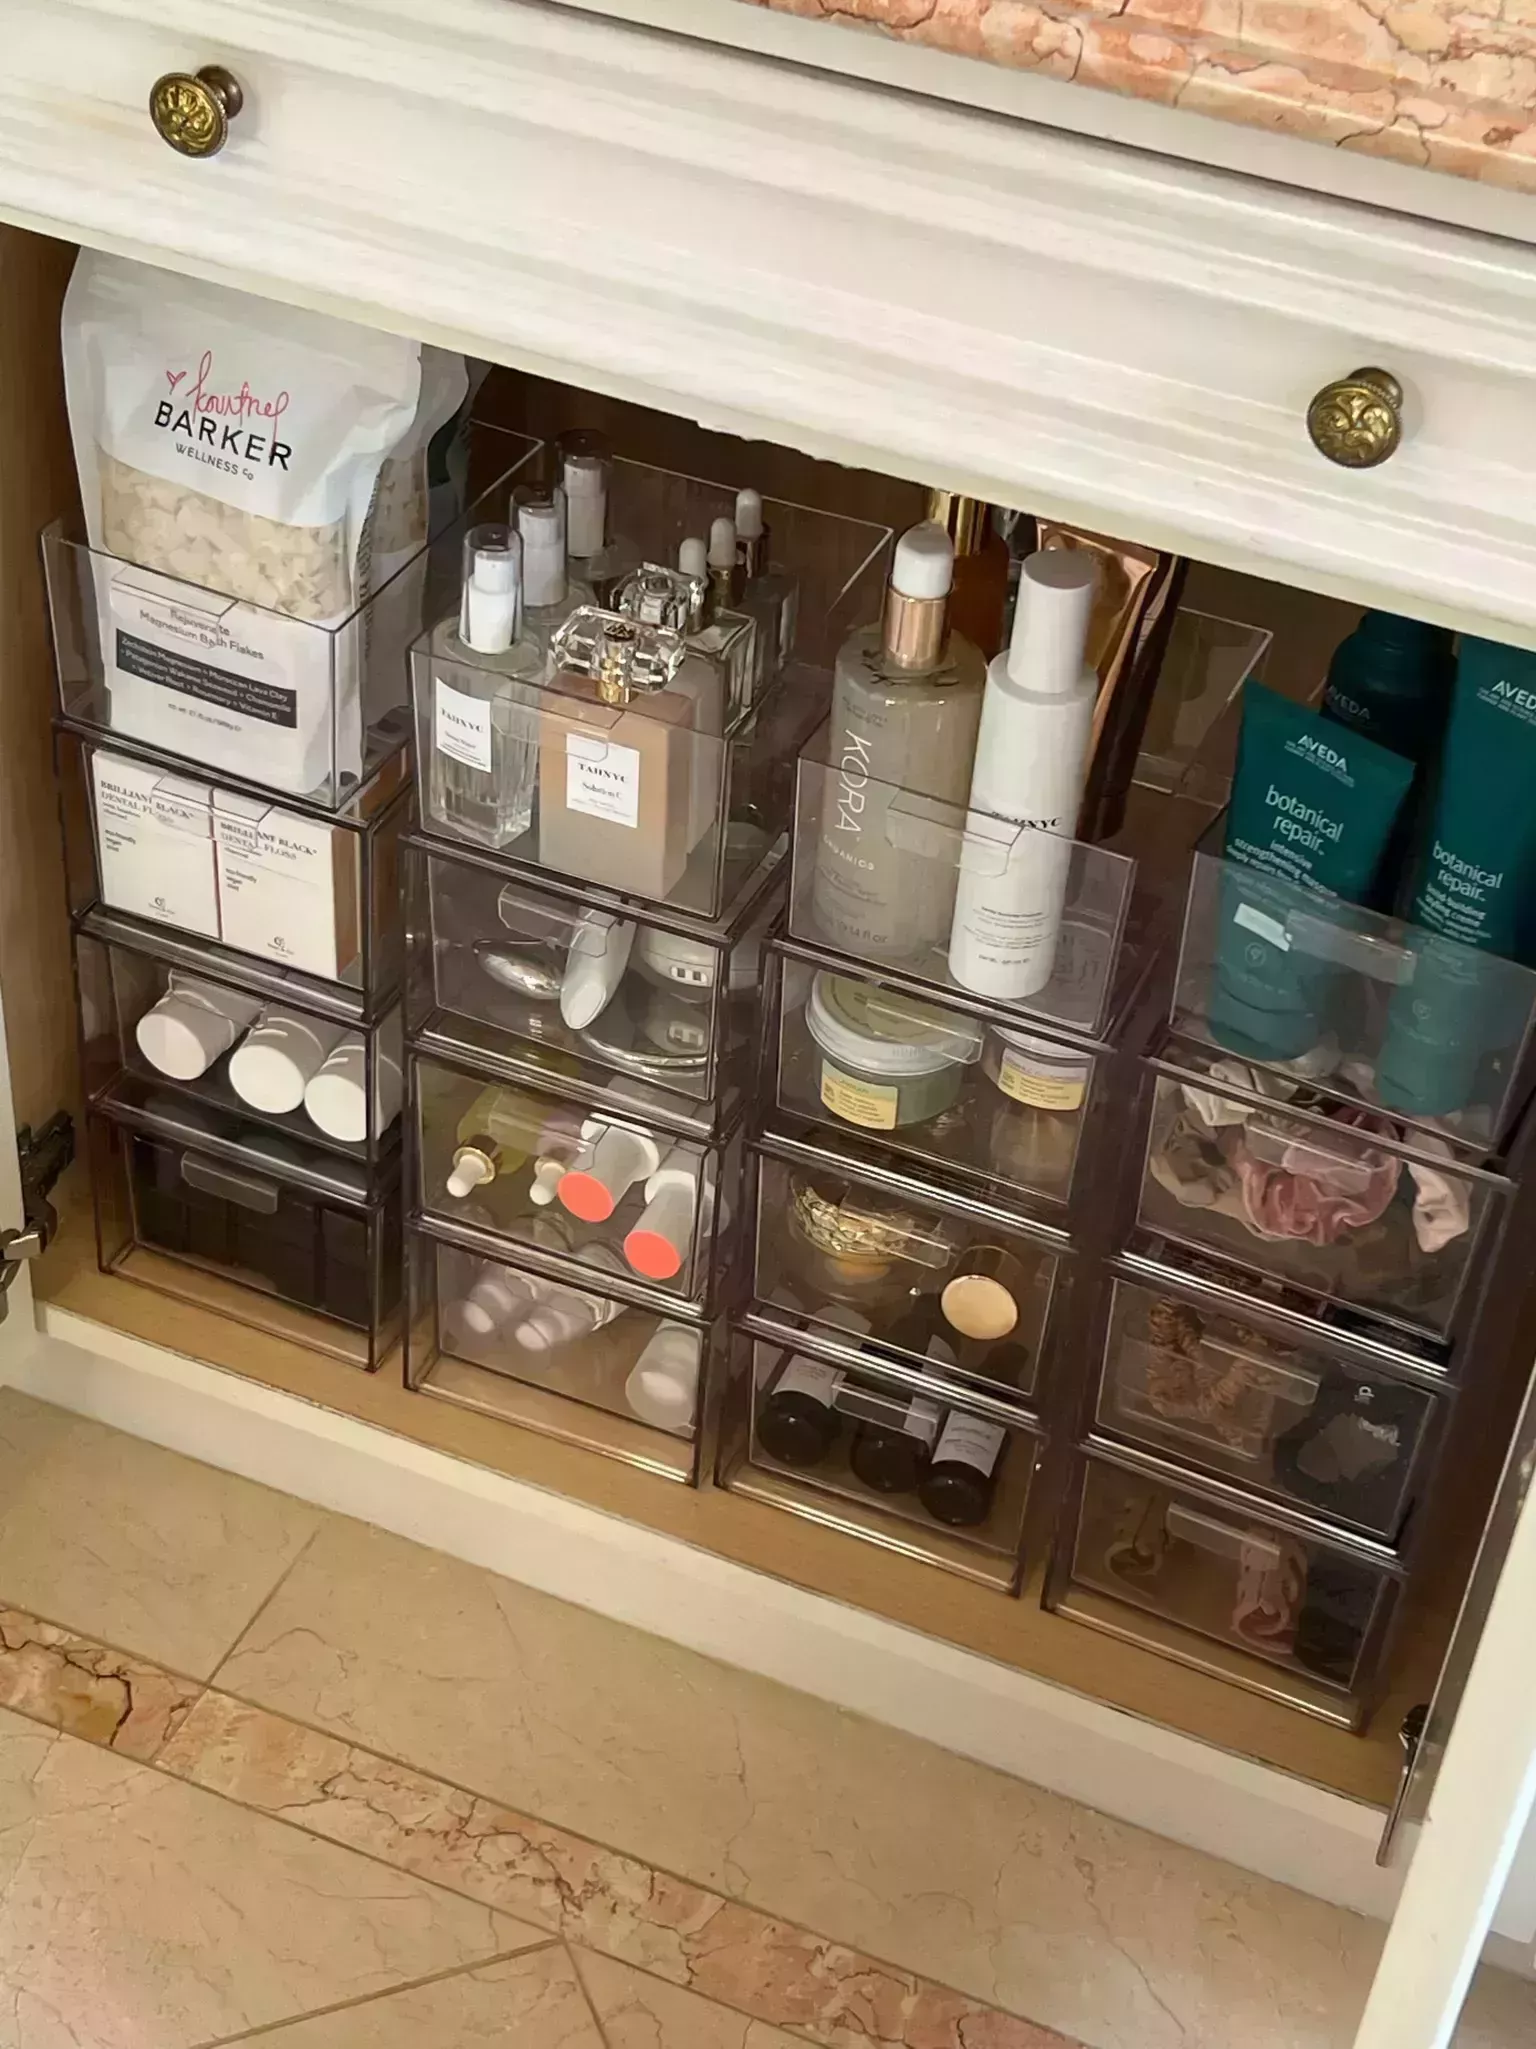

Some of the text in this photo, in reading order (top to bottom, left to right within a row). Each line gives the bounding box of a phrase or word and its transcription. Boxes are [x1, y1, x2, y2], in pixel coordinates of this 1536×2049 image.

[154, 400, 292, 471] BARKER
[176, 442, 239, 475] WELLNESS
[140, 609, 198, 641] Magnesium
[230, 641, 264, 660] Flakes
[1328, 685, 1370, 719] AVEDA
[1492, 680, 1536, 710] AVED
[1298, 734, 1348, 771] AVEDA
[835, 729, 872, 832] KORA
[1265, 785, 1344, 842] botanical
[1270, 840, 1312, 870] intensive
[1432, 840, 1503, 889] botanical
